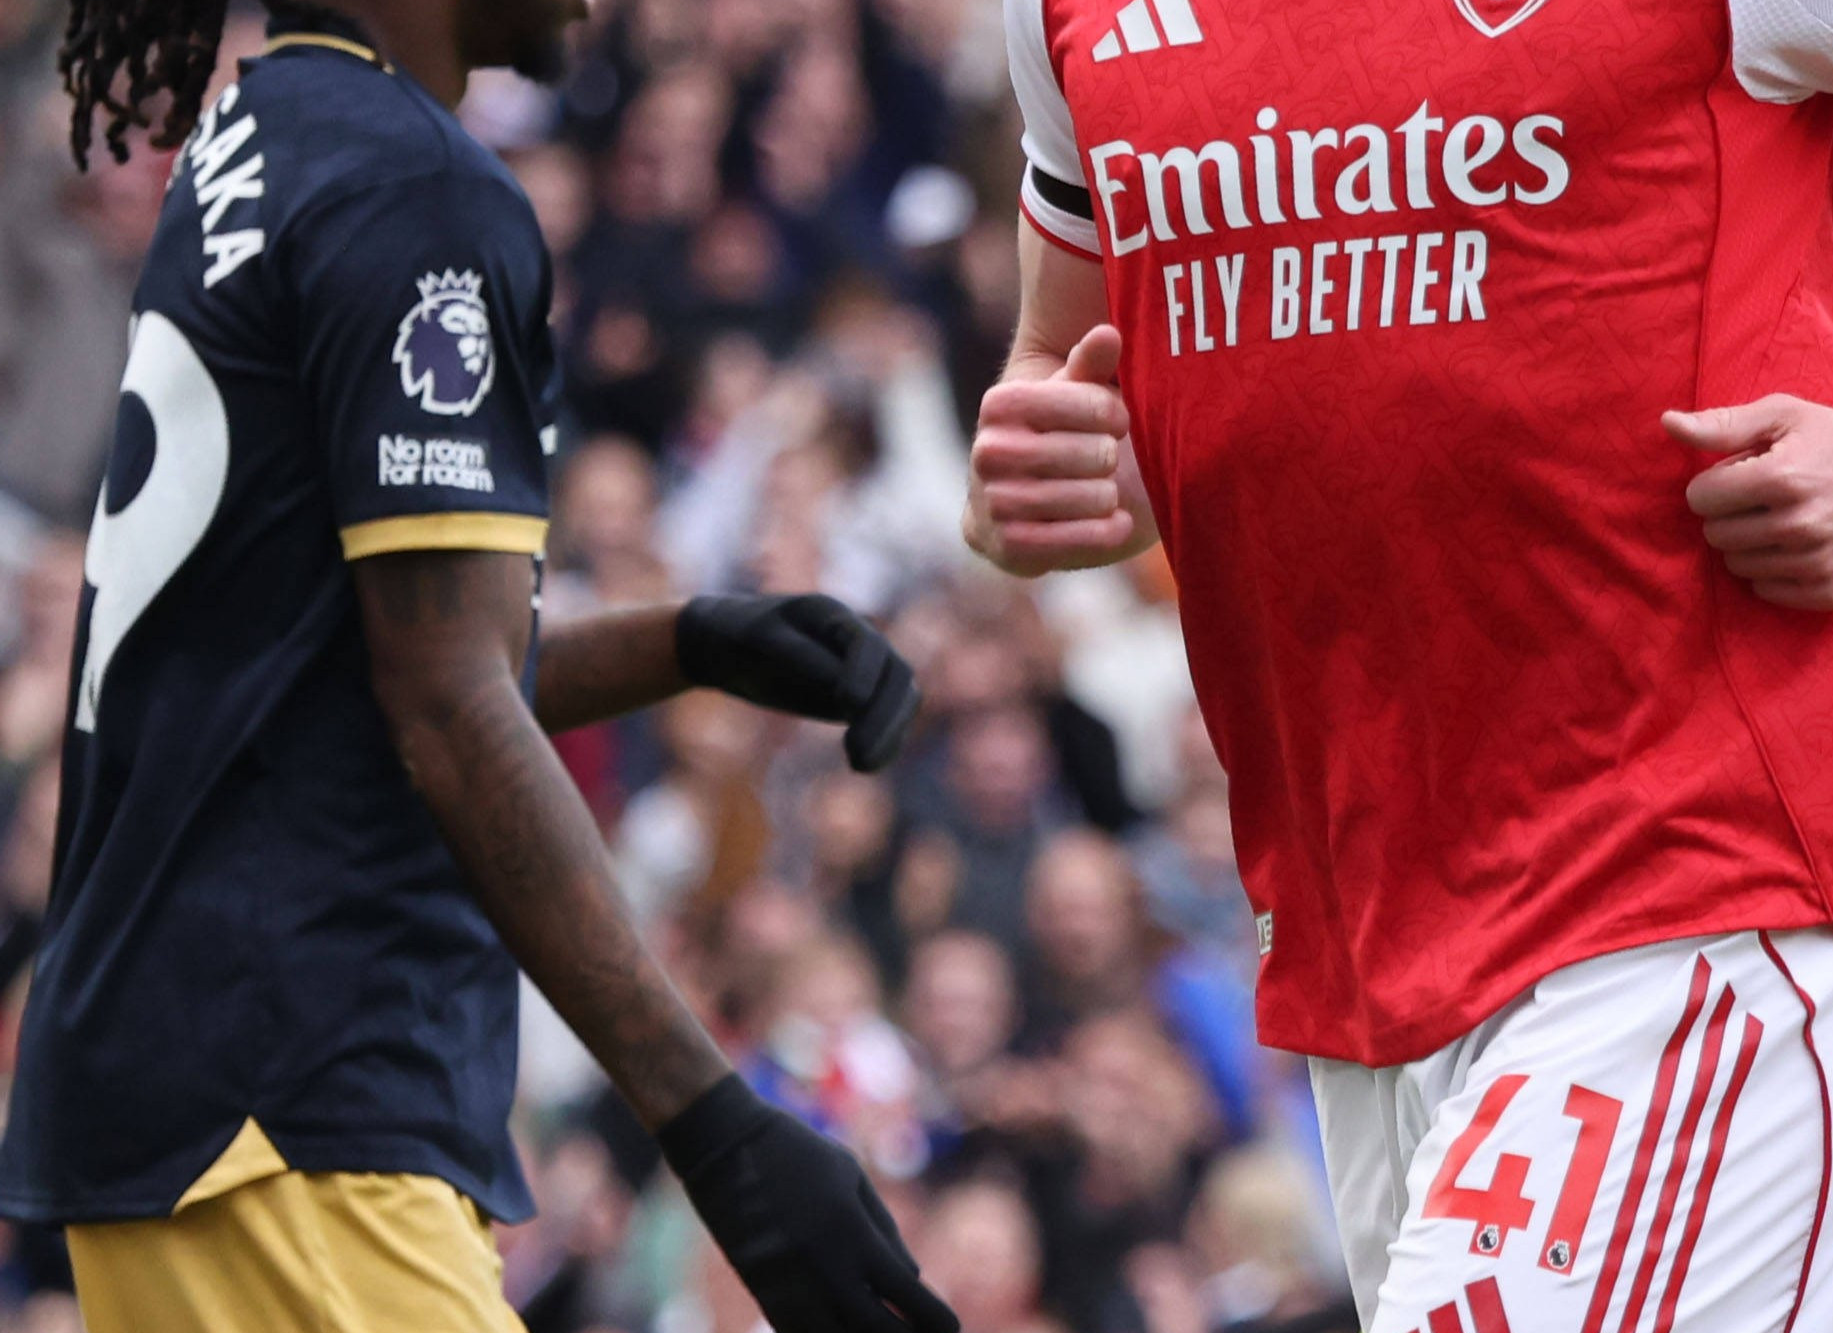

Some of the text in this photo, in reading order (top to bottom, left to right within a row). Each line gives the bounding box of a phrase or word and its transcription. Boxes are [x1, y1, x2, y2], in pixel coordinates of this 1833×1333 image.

[166, 83, 265, 290] SAKA
[1088, 99, 1568, 258] Emirates
[1164, 229, 1487, 358] FLY BETTER
[74, 310, 230, 734] 9
[378, 433, 423, 465] No
[1421, 1074, 1623, 1275] 41
